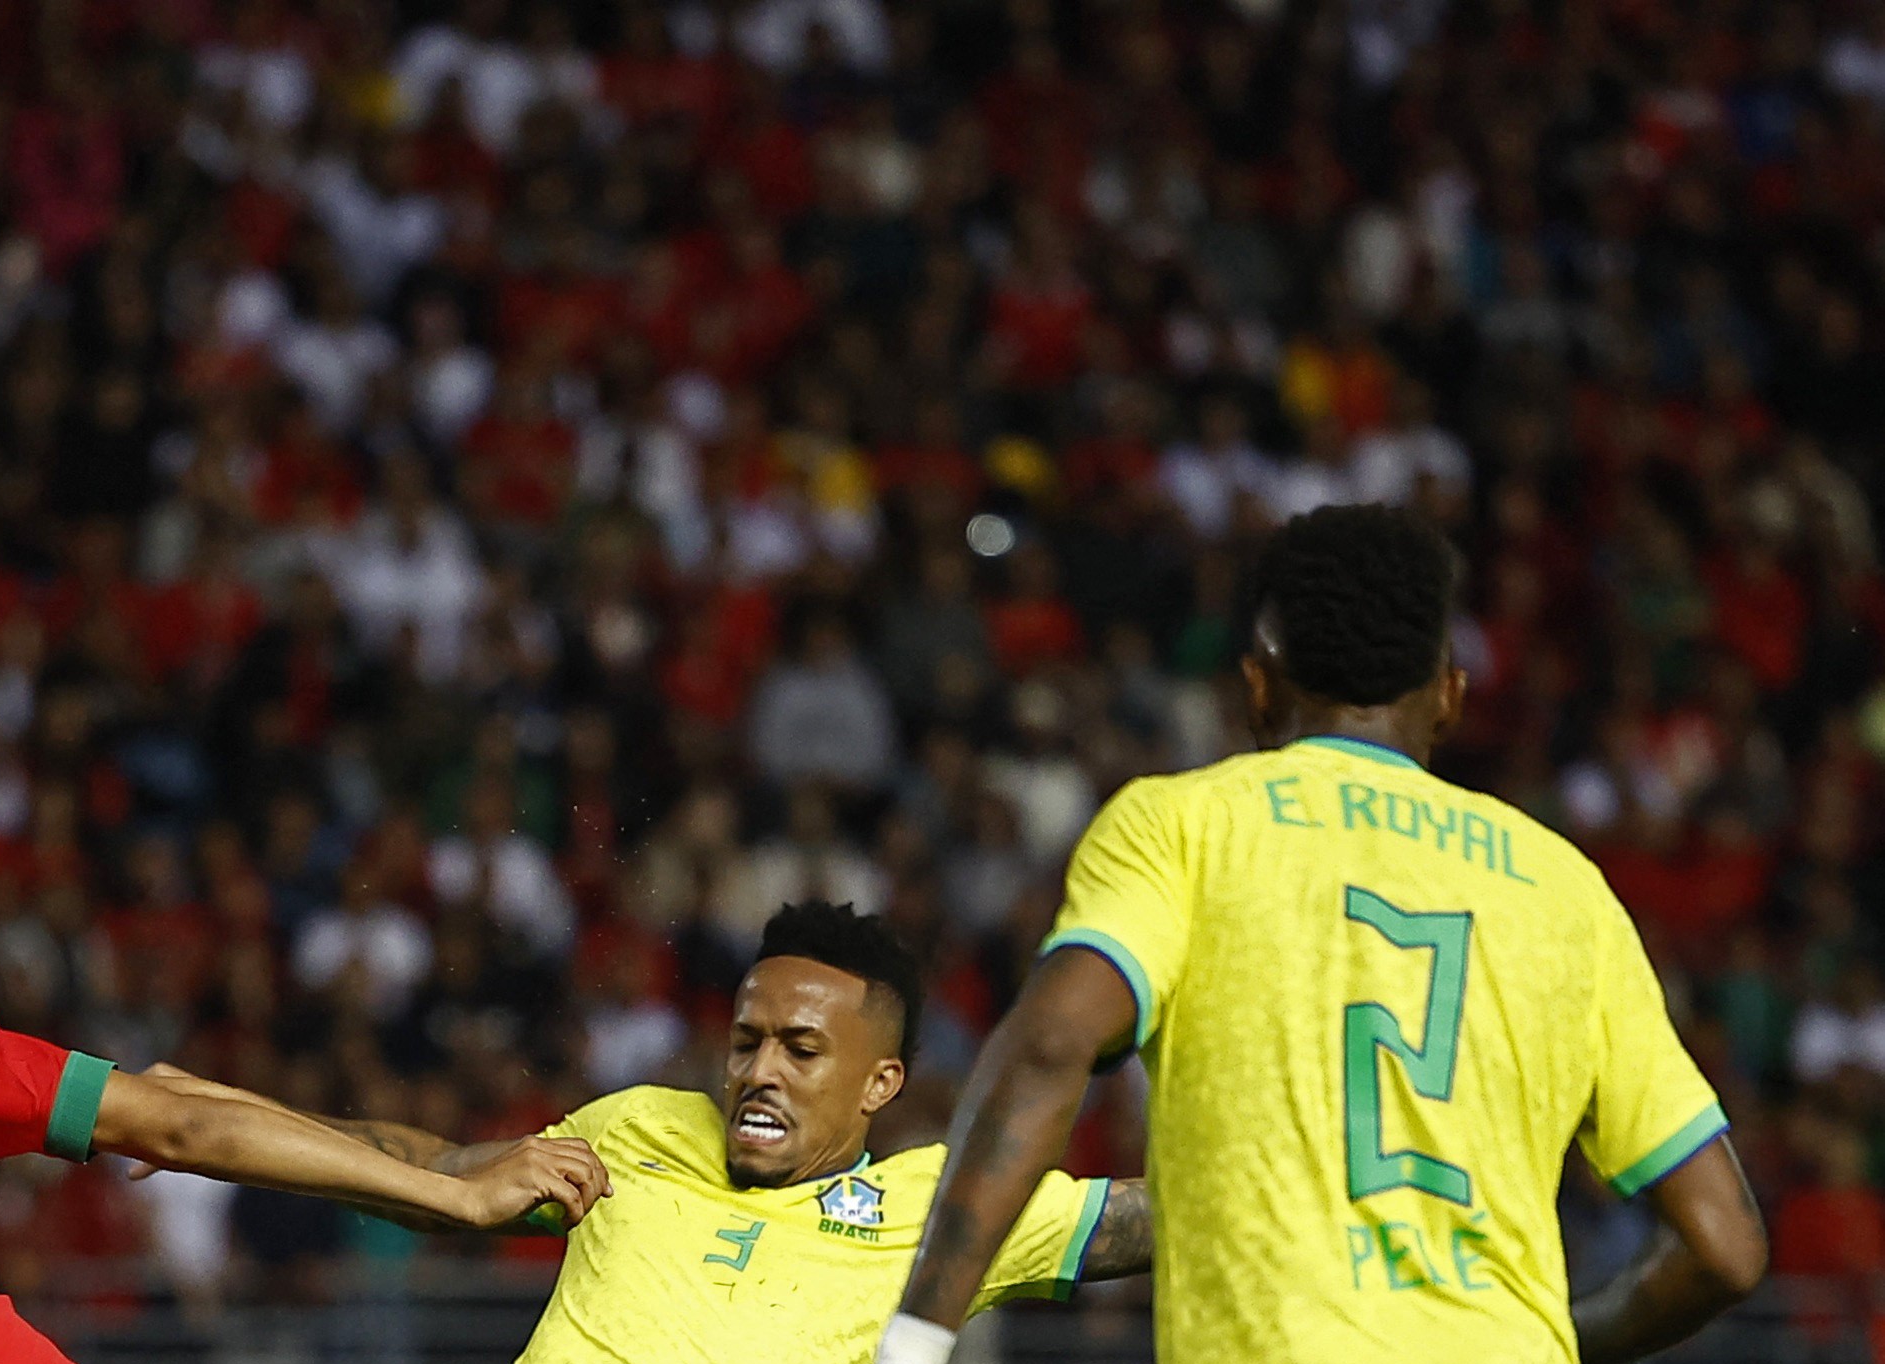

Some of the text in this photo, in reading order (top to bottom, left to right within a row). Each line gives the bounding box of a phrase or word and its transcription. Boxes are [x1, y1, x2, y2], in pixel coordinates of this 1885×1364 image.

[1338, 782, 1538, 887] ROYAL
[1344, 884, 1473, 1207] 2
[702, 1213, 767, 1272] 3
